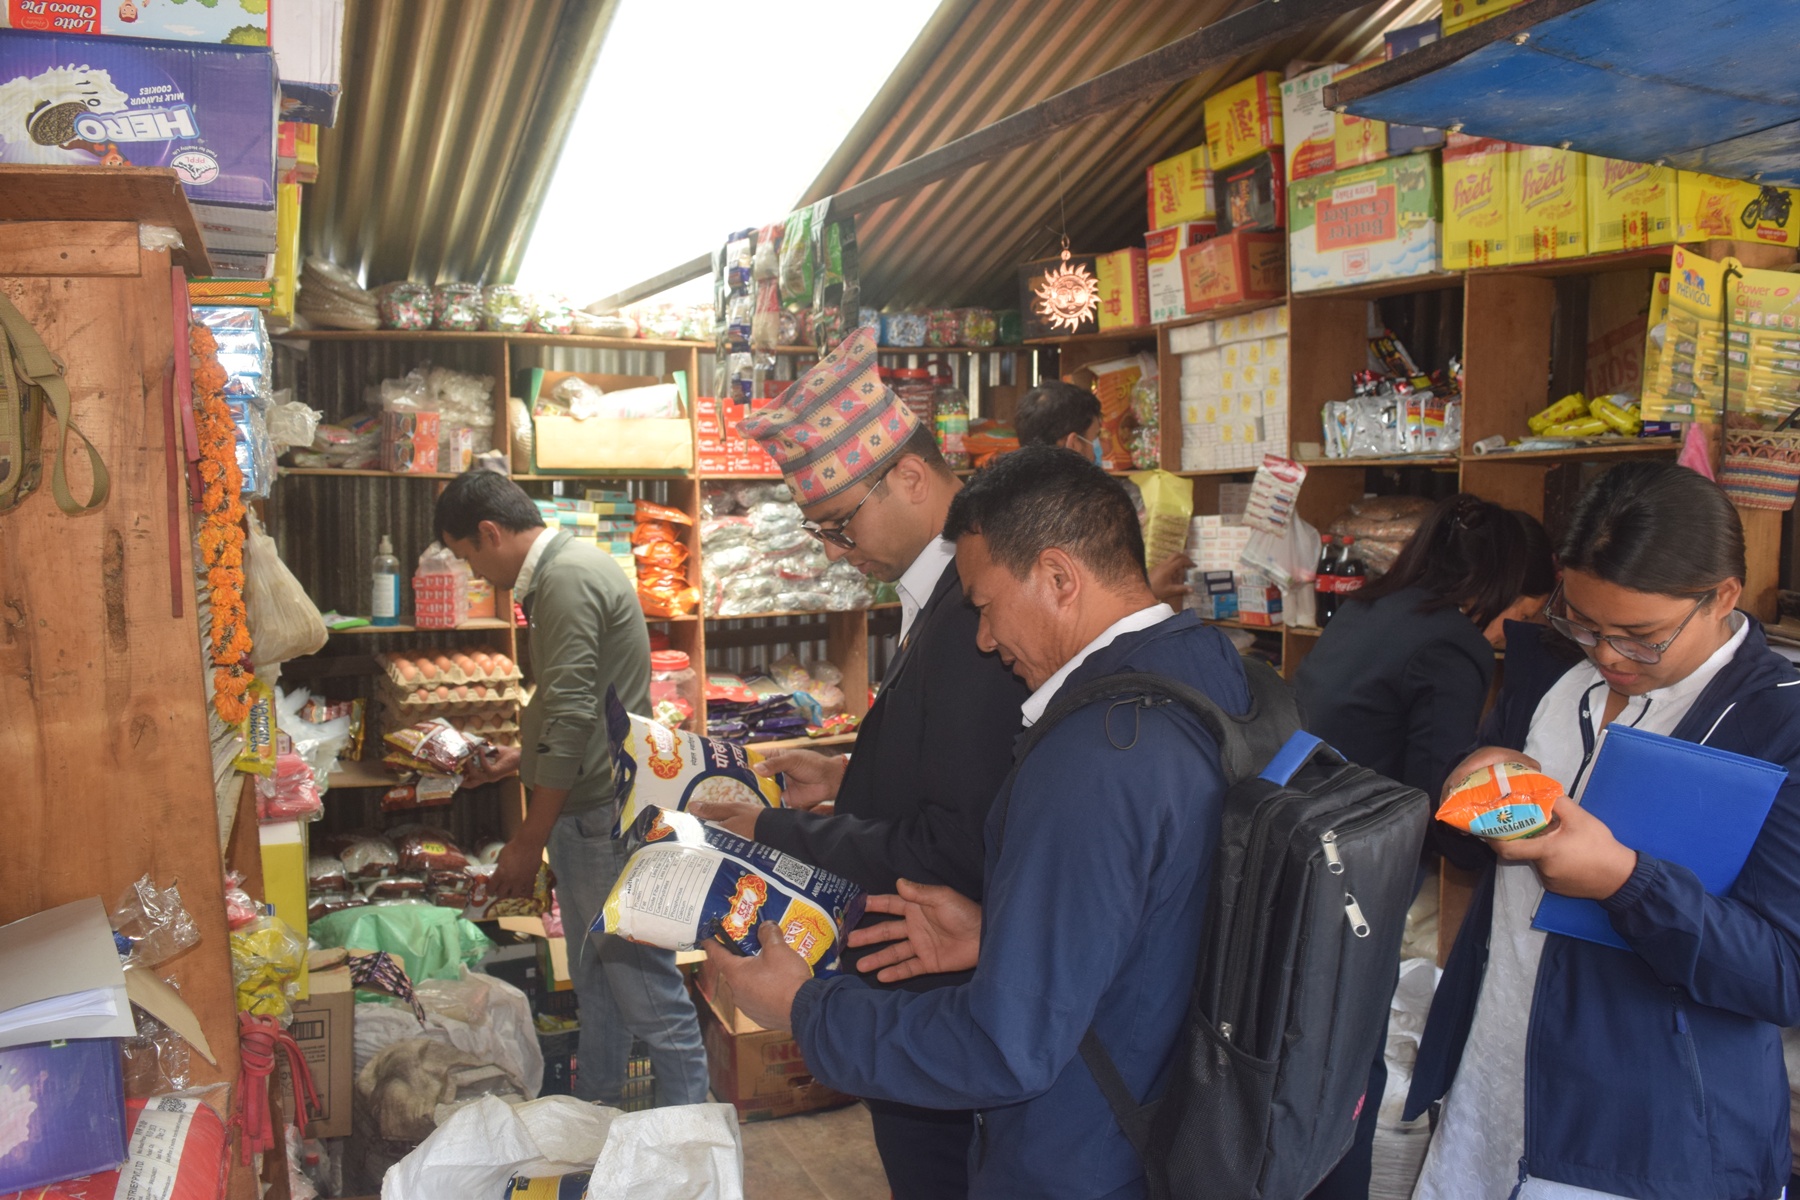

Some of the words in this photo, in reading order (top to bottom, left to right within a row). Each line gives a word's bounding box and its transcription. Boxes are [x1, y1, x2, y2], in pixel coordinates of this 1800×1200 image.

[21, 0, 48, 14] Pie
[50, 3, 96, 18] Choco
[54, 17, 96, 33] Lotte
[139, 85, 172, 95] COOKIES
[165, 92, 184, 102] MILK
[130, 96, 164, 105] FLAVOUR
[77, 108, 196, 140] HERO
[185, 156, 206, 164] PFPL
[1521, 155, 1567, 204] Preeti
[1323, 199, 1389, 224] Cracker
[1328, 219, 1383, 240] Butter
[1676, 281, 1712, 307] PHEVIGOL
[1736, 281, 1771, 297] Power
[1736, 295, 1762, 308] Glue
[249, 704, 258, 753] NAMKIN
[258, 697, 270, 746] NAMKIN
